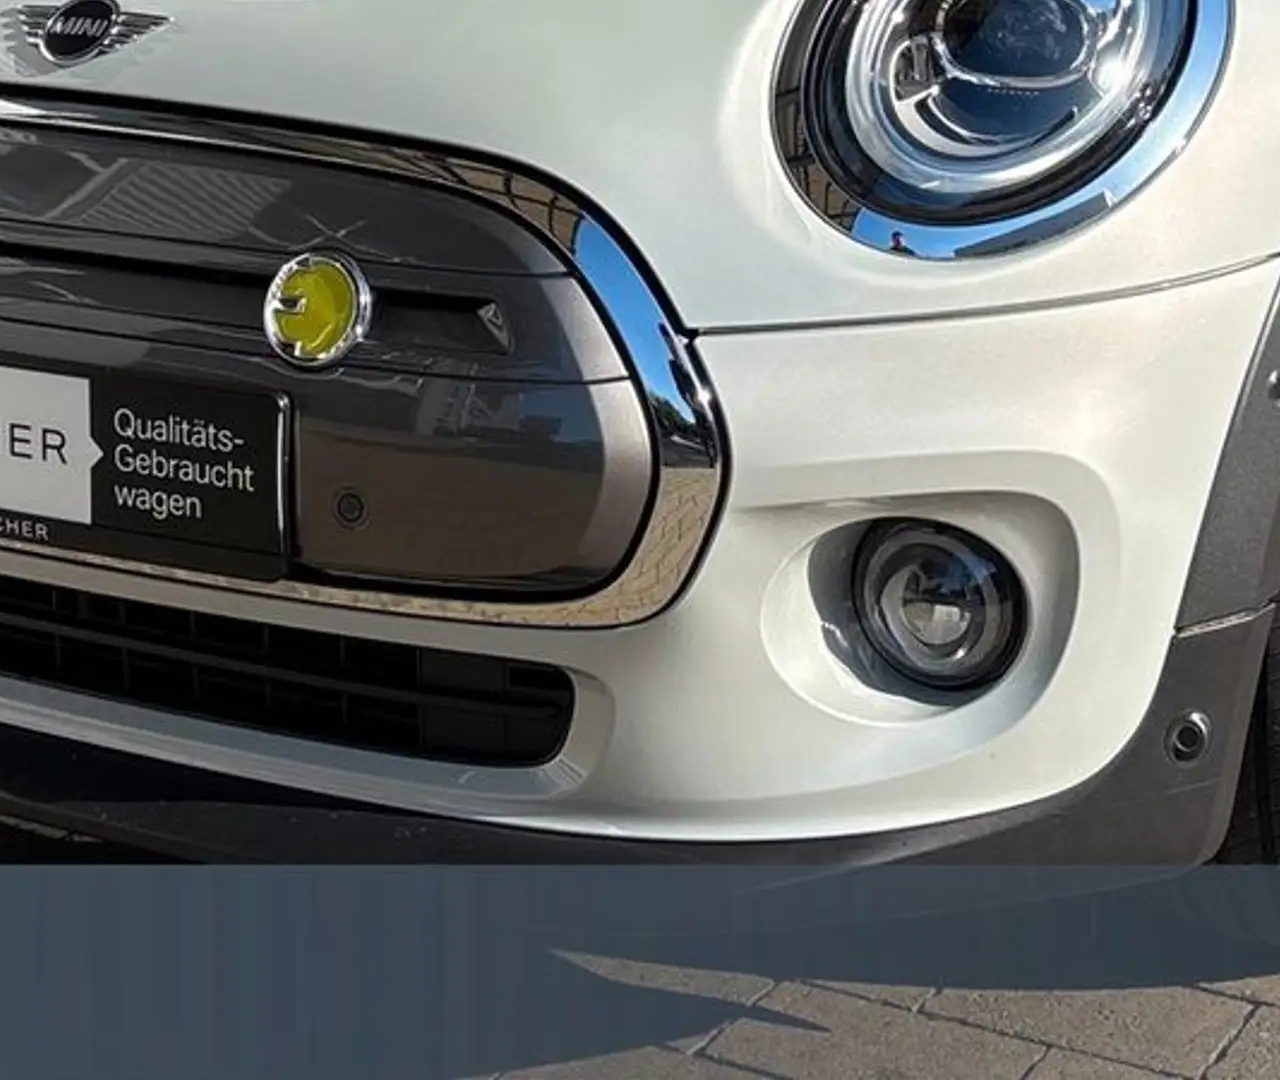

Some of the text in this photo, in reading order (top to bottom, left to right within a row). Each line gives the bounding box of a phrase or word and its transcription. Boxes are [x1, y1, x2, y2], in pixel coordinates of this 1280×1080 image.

[51, 16, 108, 37] MINI
[113, 408, 244, 452] Qualitäts-
[114, 444, 254, 492] Gebraucht
[113, 485, 202, 520] wagen
